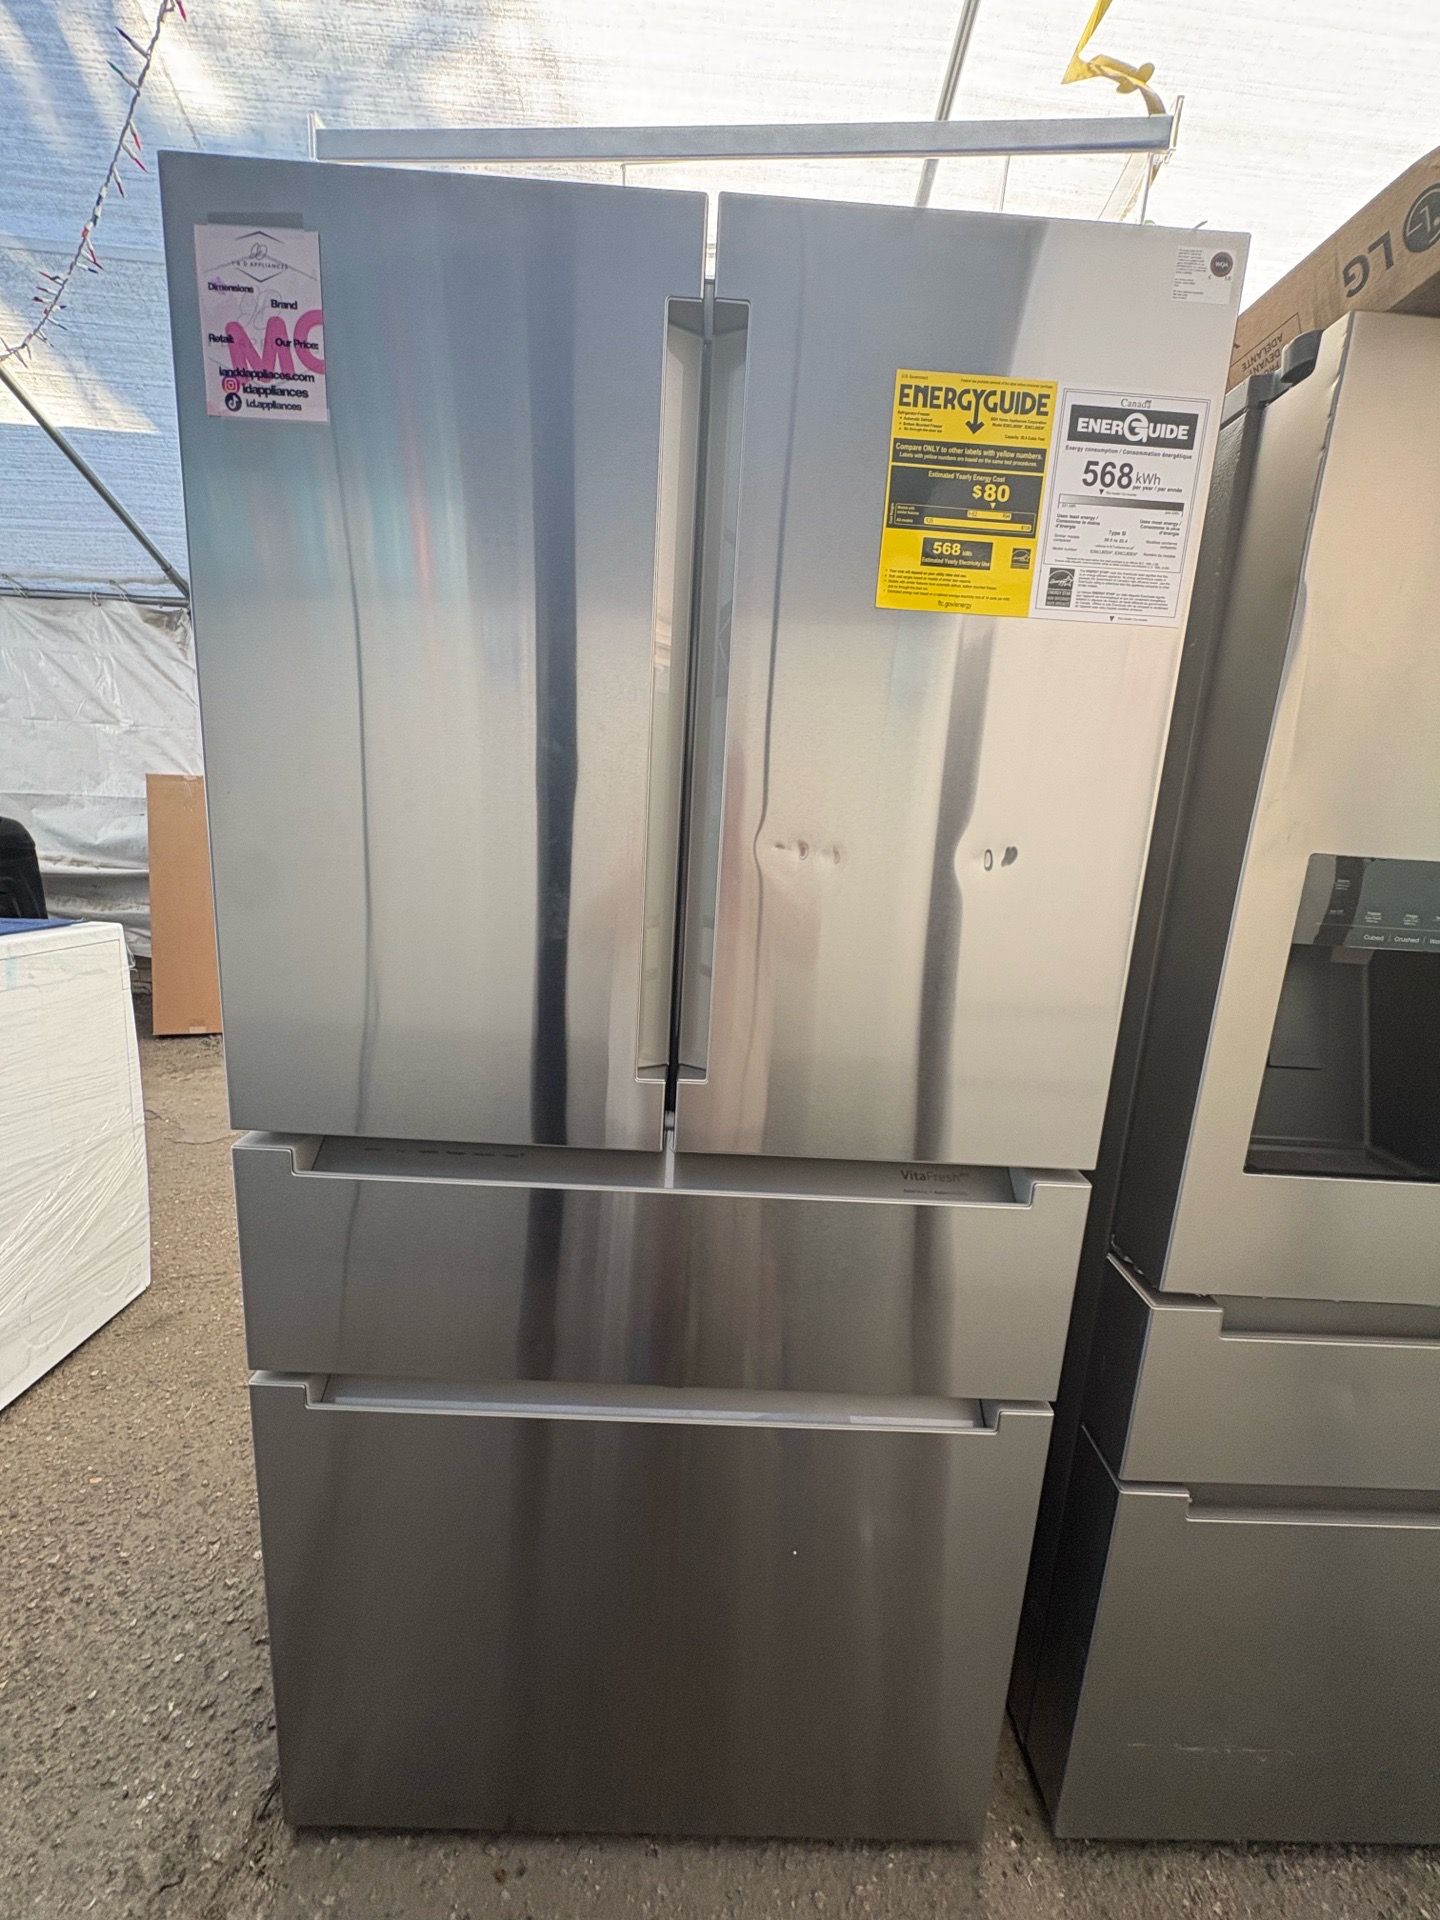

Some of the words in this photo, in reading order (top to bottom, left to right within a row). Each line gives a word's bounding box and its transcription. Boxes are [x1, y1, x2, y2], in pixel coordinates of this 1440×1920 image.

[1343, 230, 1394, 298] LG
[207, 282, 254, 294] Dimensions
[270, 299, 298, 310] Brand
[275, 338, 292, 348] Our
[293, 339, 319, 350] Price:
[1241, 333, 1283, 372] ADELANTE
[899, 384, 1050, 418] ENERGYGUIDE
[1120, 398, 1152, 409] Canada
[1077, 412, 1190, 443] ENERGUIDE
[896, 442, 921, 452] Compare
[923, 444, 940, 453] ONLY
[1065, 444, 1084, 453] Energy
[1085, 446, 1118, 455] consumption
[1123, 448, 1161, 457] Consommation
[928, 471, 954, 480] Estimated
[956, 472, 972, 482] Yearly
[973, 474, 992, 483] Energy
[993, 475, 1005, 483] Cost
[1082, 460, 1134, 489] 568
[1136, 471, 1161, 486] kWh
[972, 484, 1010, 502] $80
[932, 541, 961, 556] 568
[1363, 934, 1385, 942] Cubed
